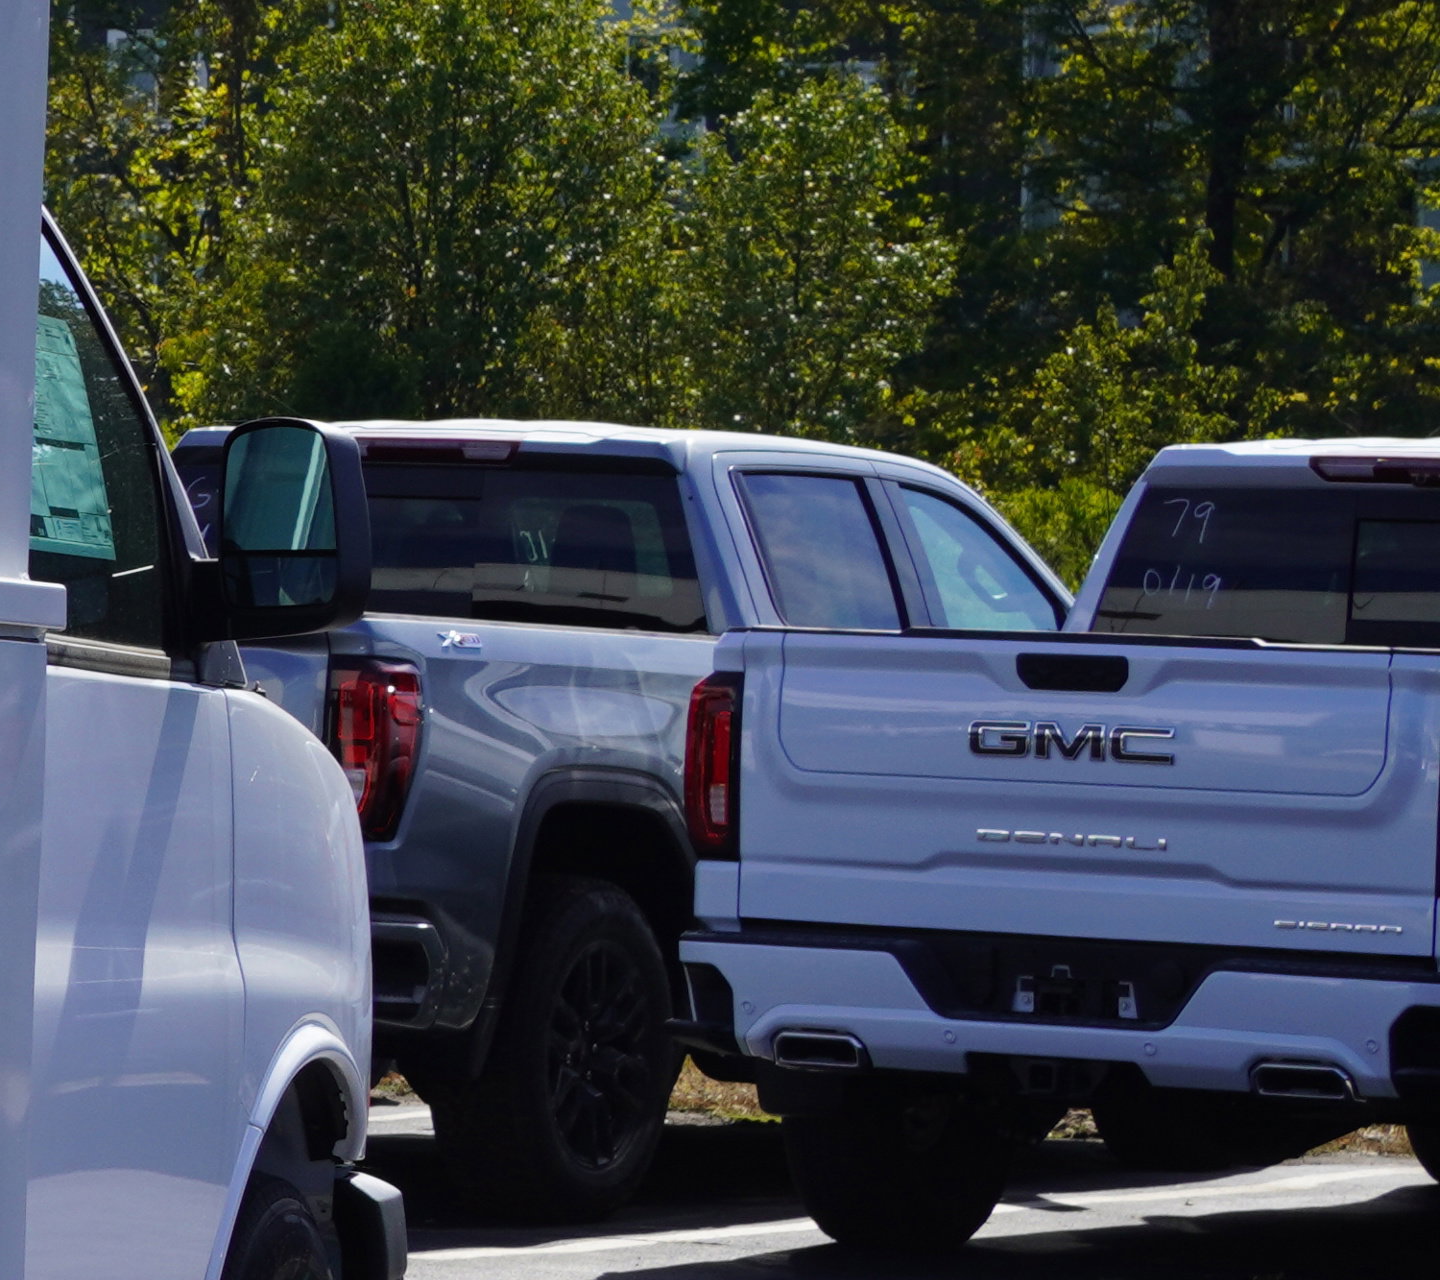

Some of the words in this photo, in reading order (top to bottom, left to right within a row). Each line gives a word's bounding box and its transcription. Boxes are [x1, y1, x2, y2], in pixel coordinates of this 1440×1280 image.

[1164, 498, 1215, 544] 79
[968, 719, 1176, 766] GMC
[976, 828, 1168, 852] DENALI
